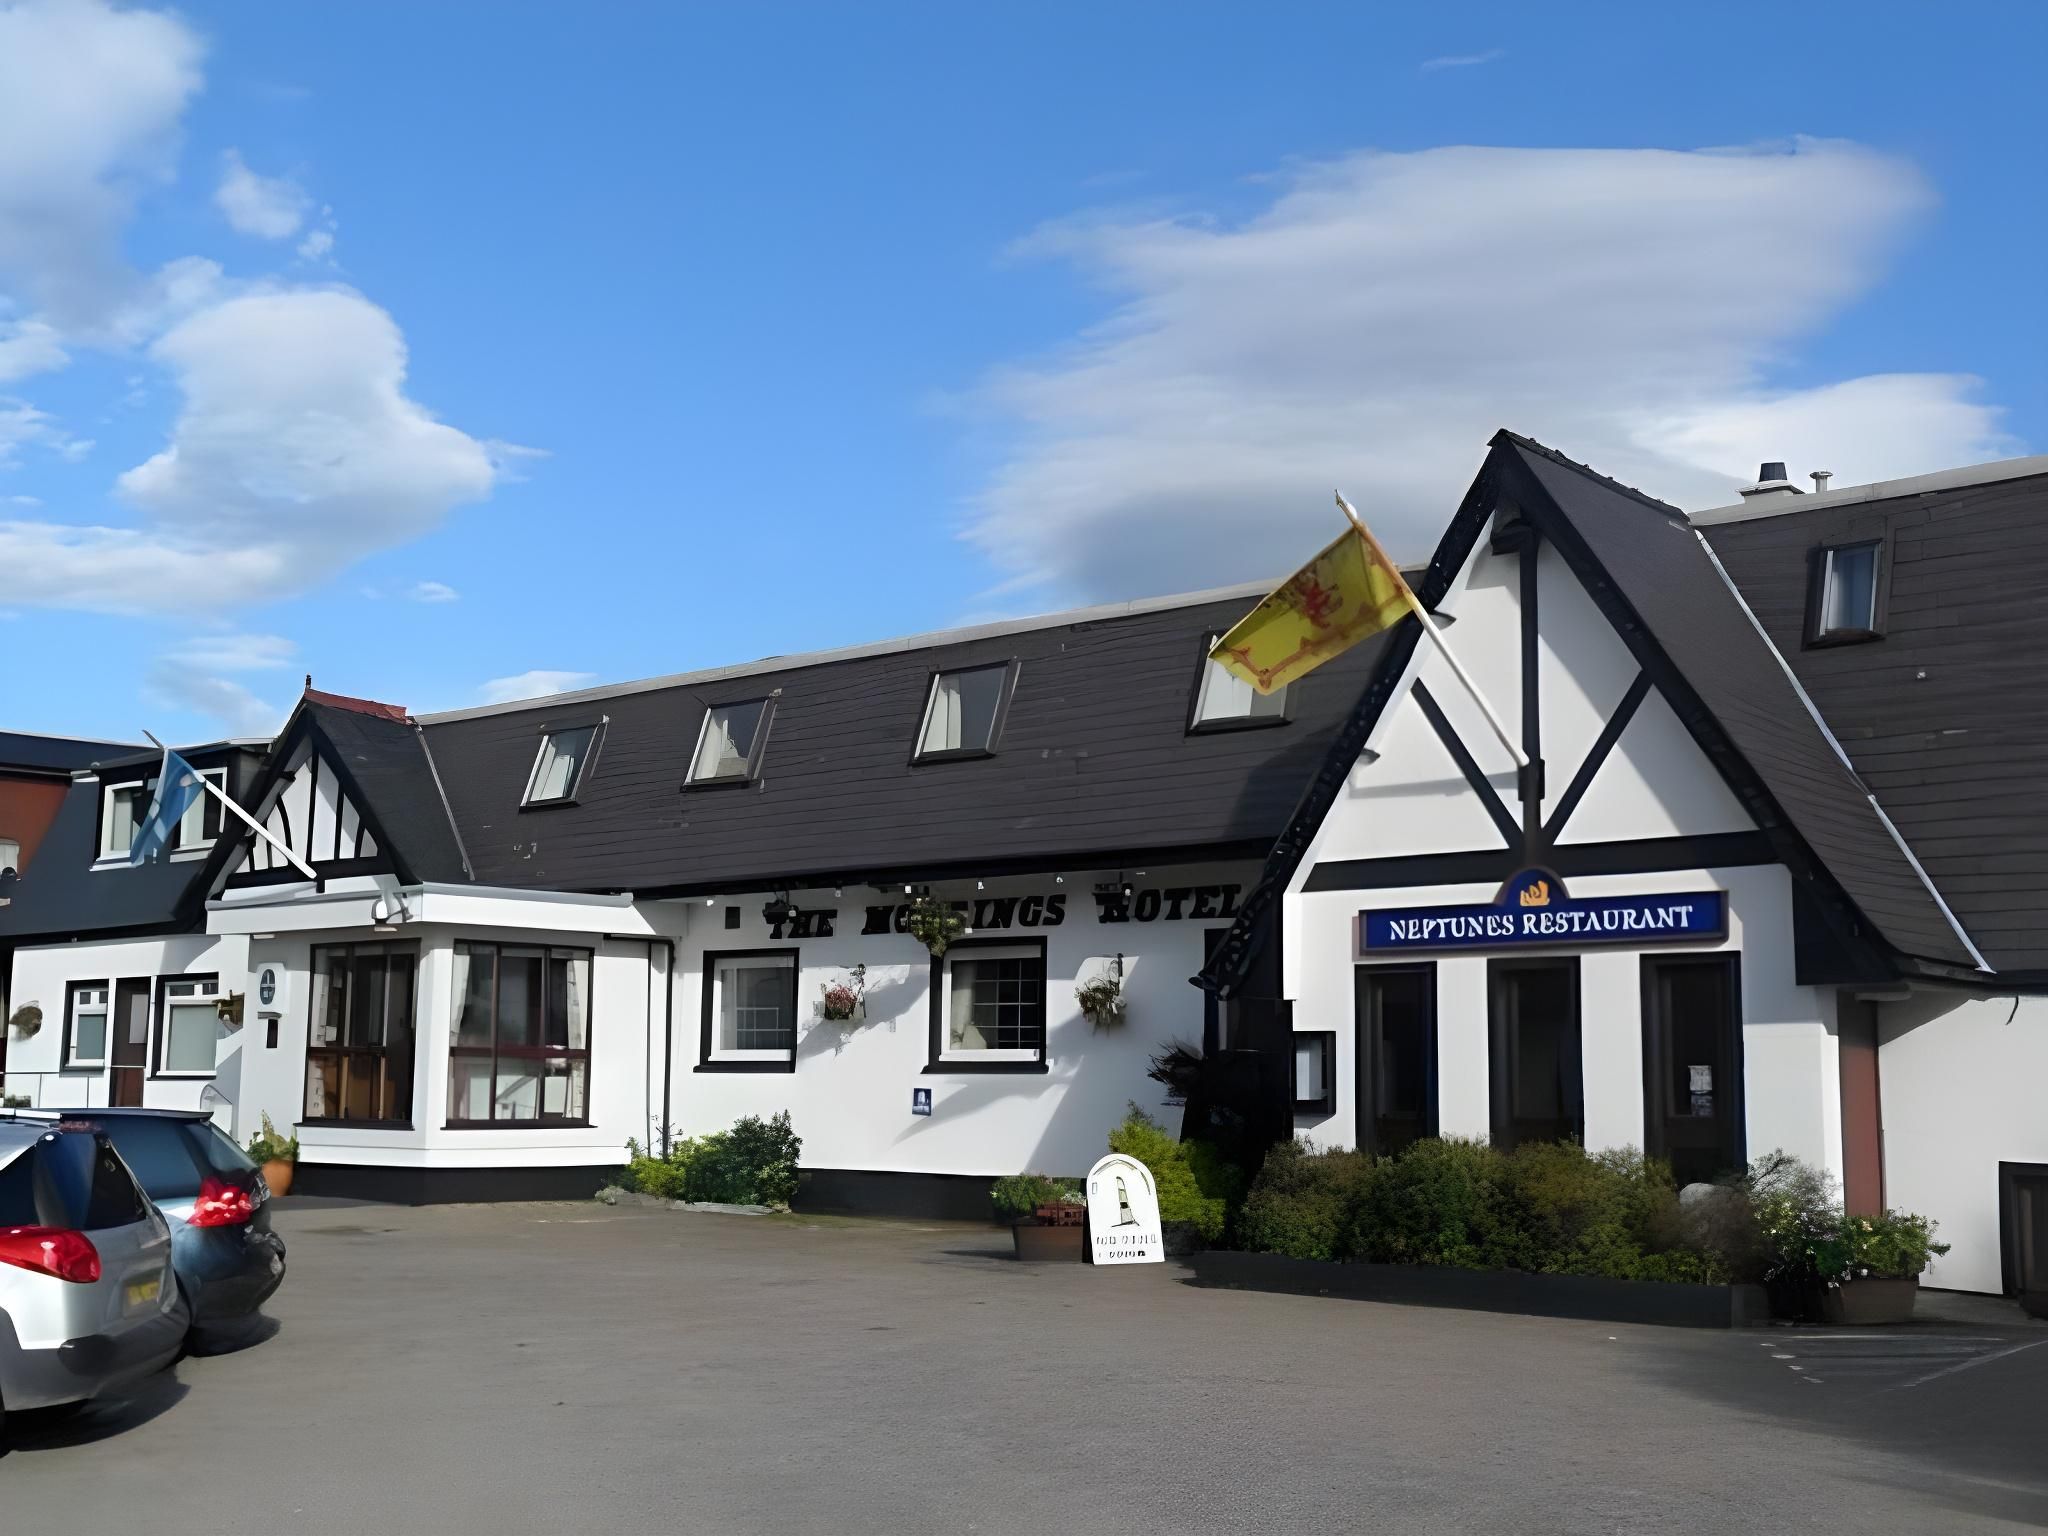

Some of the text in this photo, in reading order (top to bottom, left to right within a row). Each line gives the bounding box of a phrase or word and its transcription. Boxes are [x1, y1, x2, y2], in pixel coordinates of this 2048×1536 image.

[860, 894, 1067, 935] MOINGS
[1389, 905, 1693, 941] NEPTUNES RESTAURANT
